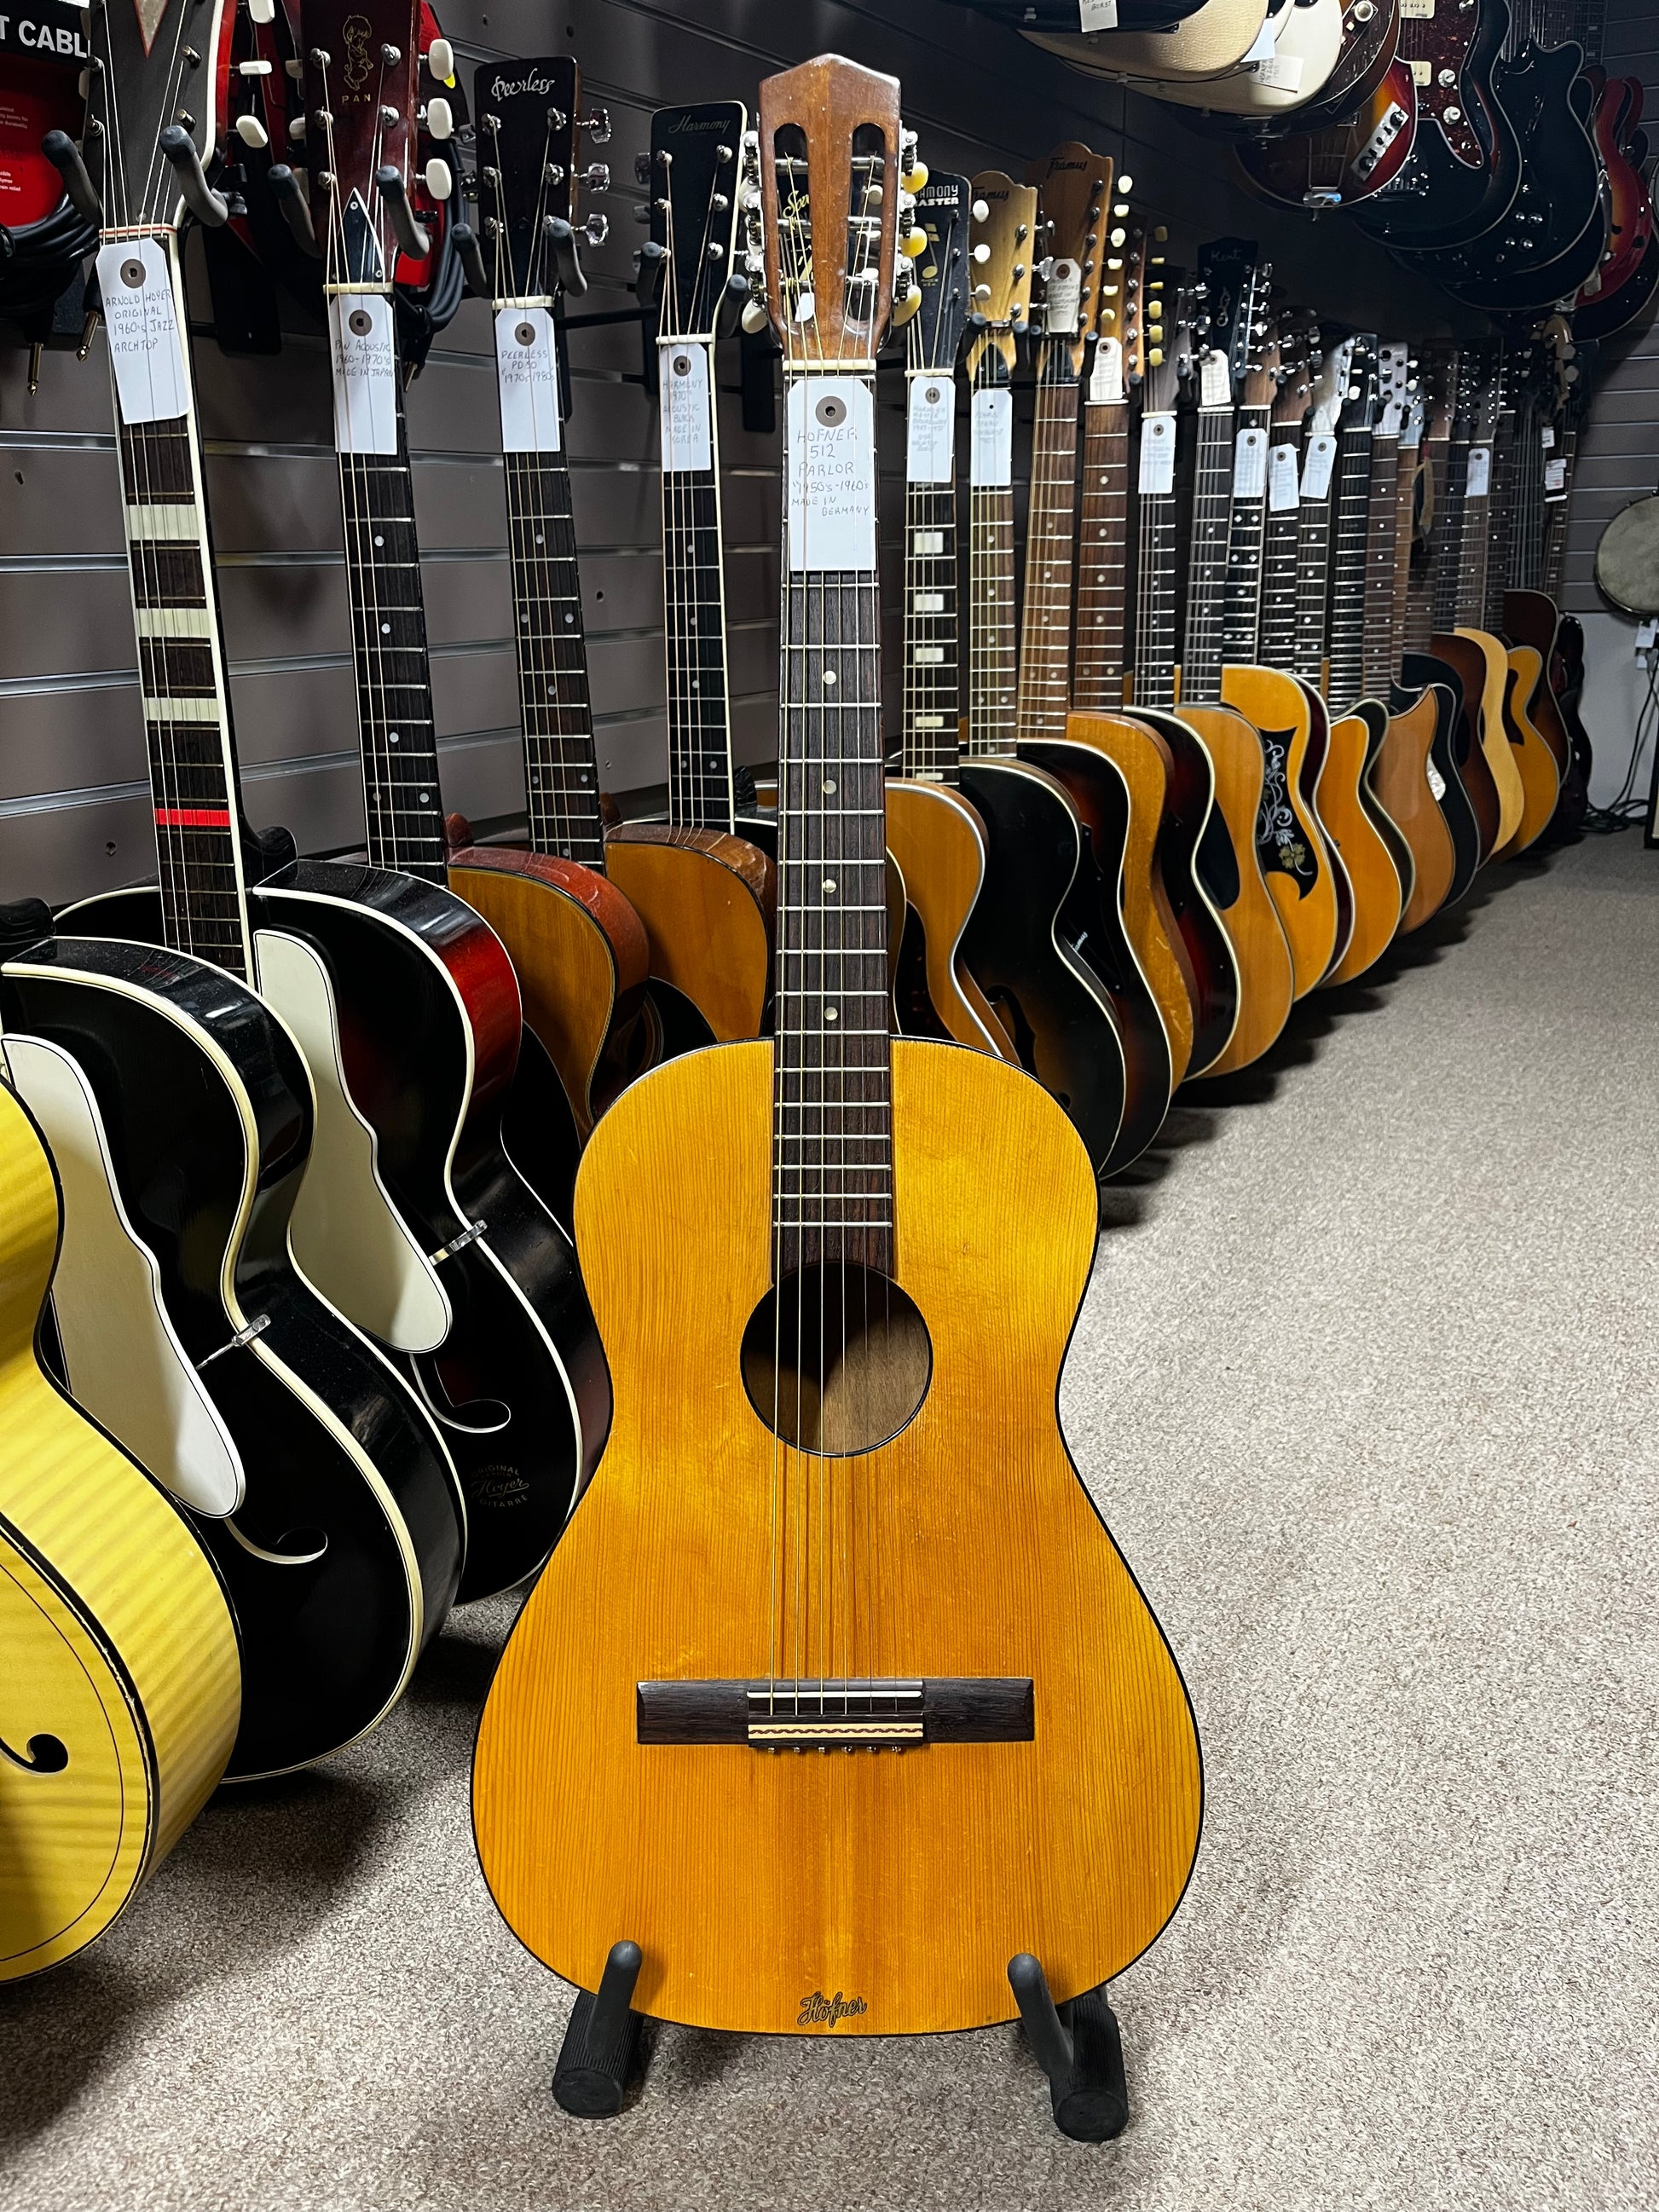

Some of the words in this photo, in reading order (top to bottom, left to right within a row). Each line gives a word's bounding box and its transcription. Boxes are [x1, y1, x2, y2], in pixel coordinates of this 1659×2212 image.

[18, 20, 91, 59] CABL
[491, 67, 556, 102] Peerless
[341, 94, 371, 103] PAN
[668, 114, 731, 135] Harmony
[916, 196, 959, 207] ASTER
[105, 294, 141, 308] ARNOLD
[145, 288, 171, 303] HOYER
[114, 306, 162, 320] ORIGINAL
[149, 319, 175, 332] JAZZ
[501, 349, 548, 360] PEERLESS
[797, 427, 858, 443] HOFNER
[810, 443, 835, 459] 512
[799, 461, 854, 477] PARLOR
[791, 497, 818, 506] MADE
[824, 496, 836, 505] IN
[822, 505, 870, 517] GERMANY
[796, 1990, 868, 2029] Höfner
